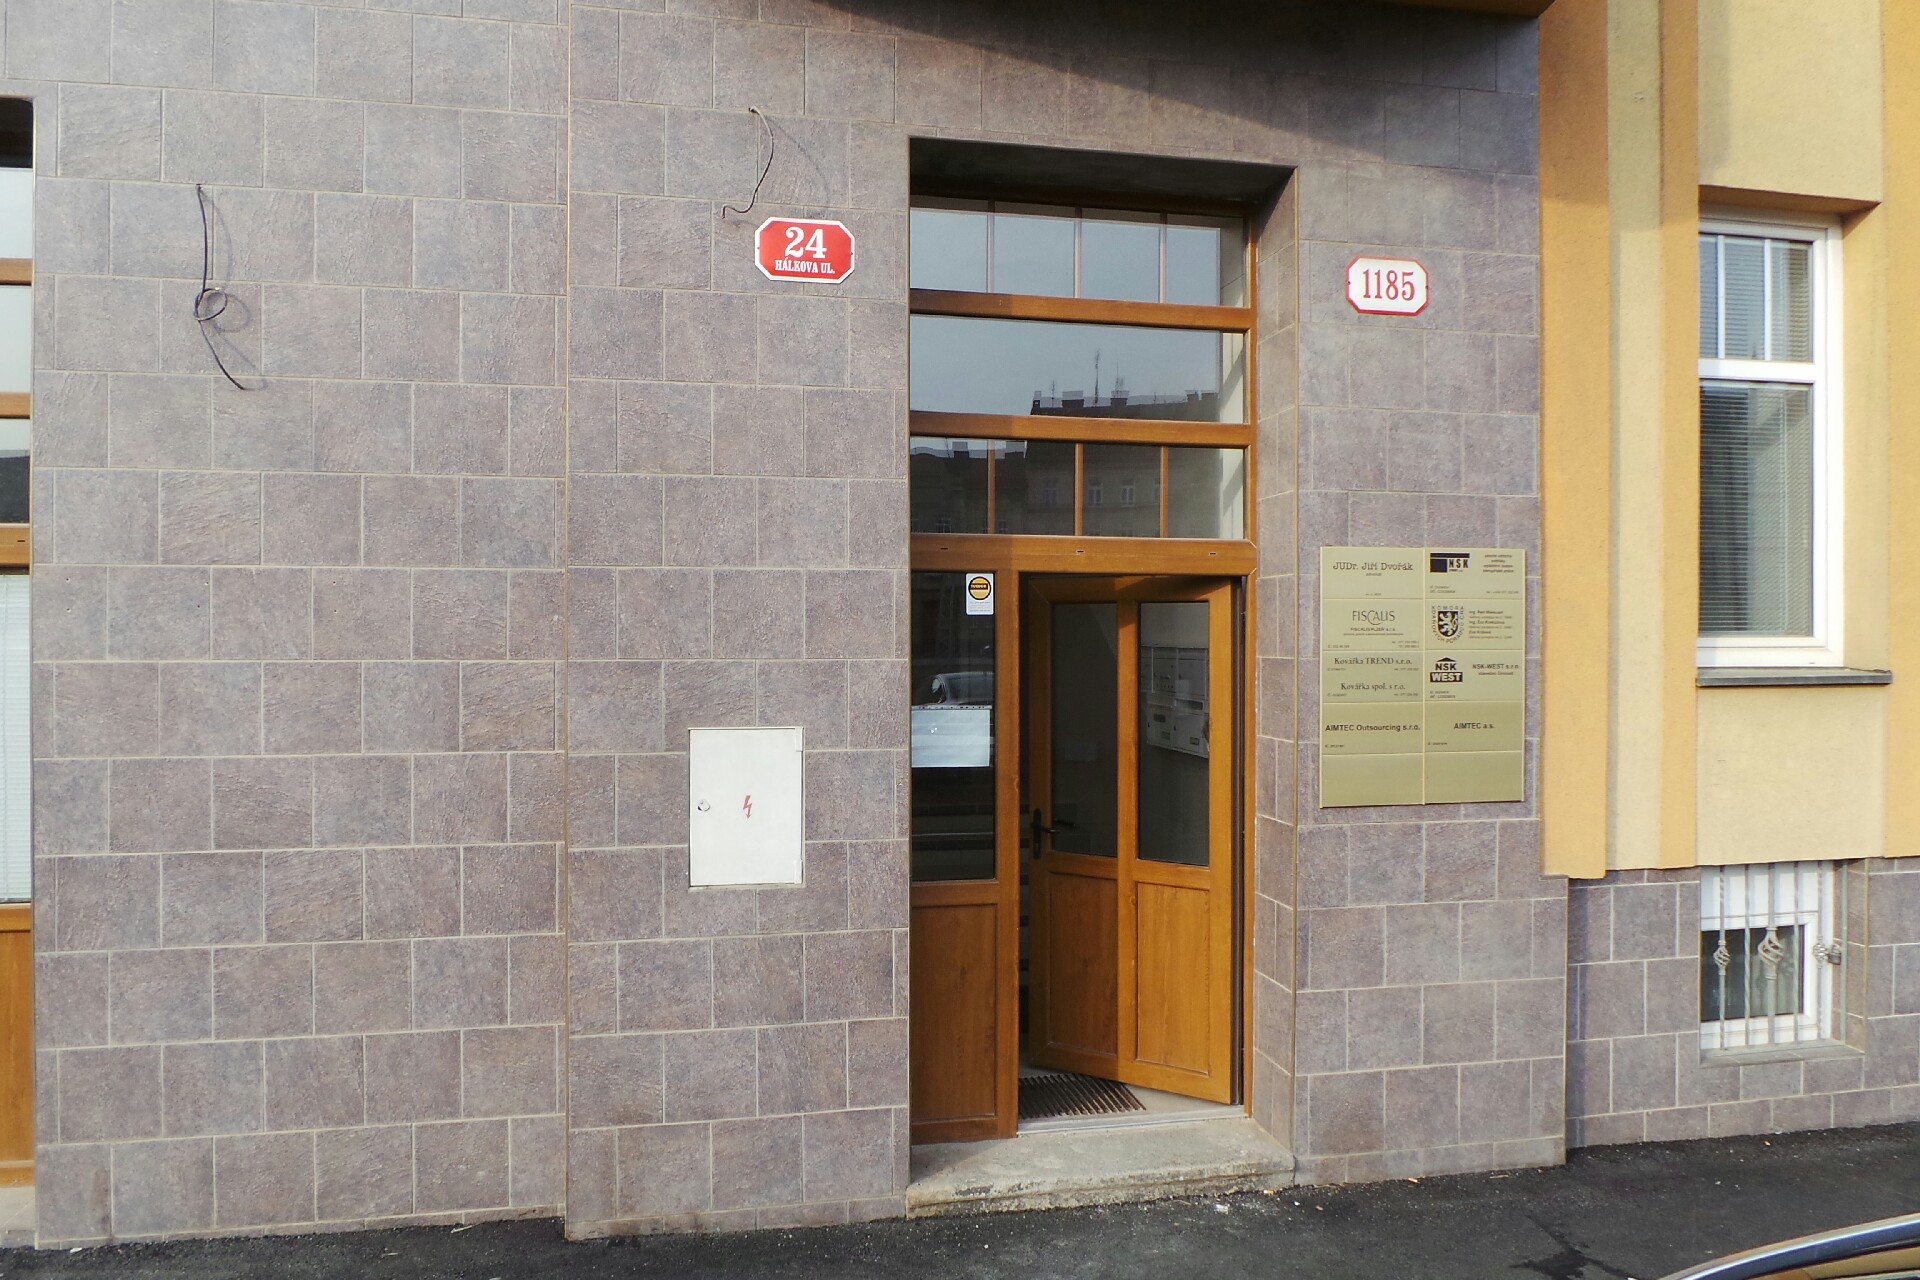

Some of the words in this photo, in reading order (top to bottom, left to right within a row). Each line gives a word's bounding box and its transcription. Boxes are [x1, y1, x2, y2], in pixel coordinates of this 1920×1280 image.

[785, 226, 827, 259] 24
[774, 257, 819, 274] HÁLKOVA
[820, 262, 836, 274] UL.
[1363, 268, 1415, 301] 1185
[1333, 561, 1358, 570] JUDr.
[1361, 561, 1378, 570] Jiří
[1380, 561, 1414, 571] Dvořák
[1448, 558, 1469, 569] NSK
[1352, 610, 1396, 625] FISCALIS
[1334, 657, 1364, 665] Kovářka
[1365, 657, 1394, 665] TREND
[1435, 663, 1457, 671] NSK
[1431, 672, 1462, 682] WEST
[1340, 682, 1370, 690] Kovářka
[1356, 724, 1401, 732] Outsourcing
[1454, 722, 1482, 730] AIMTEC
